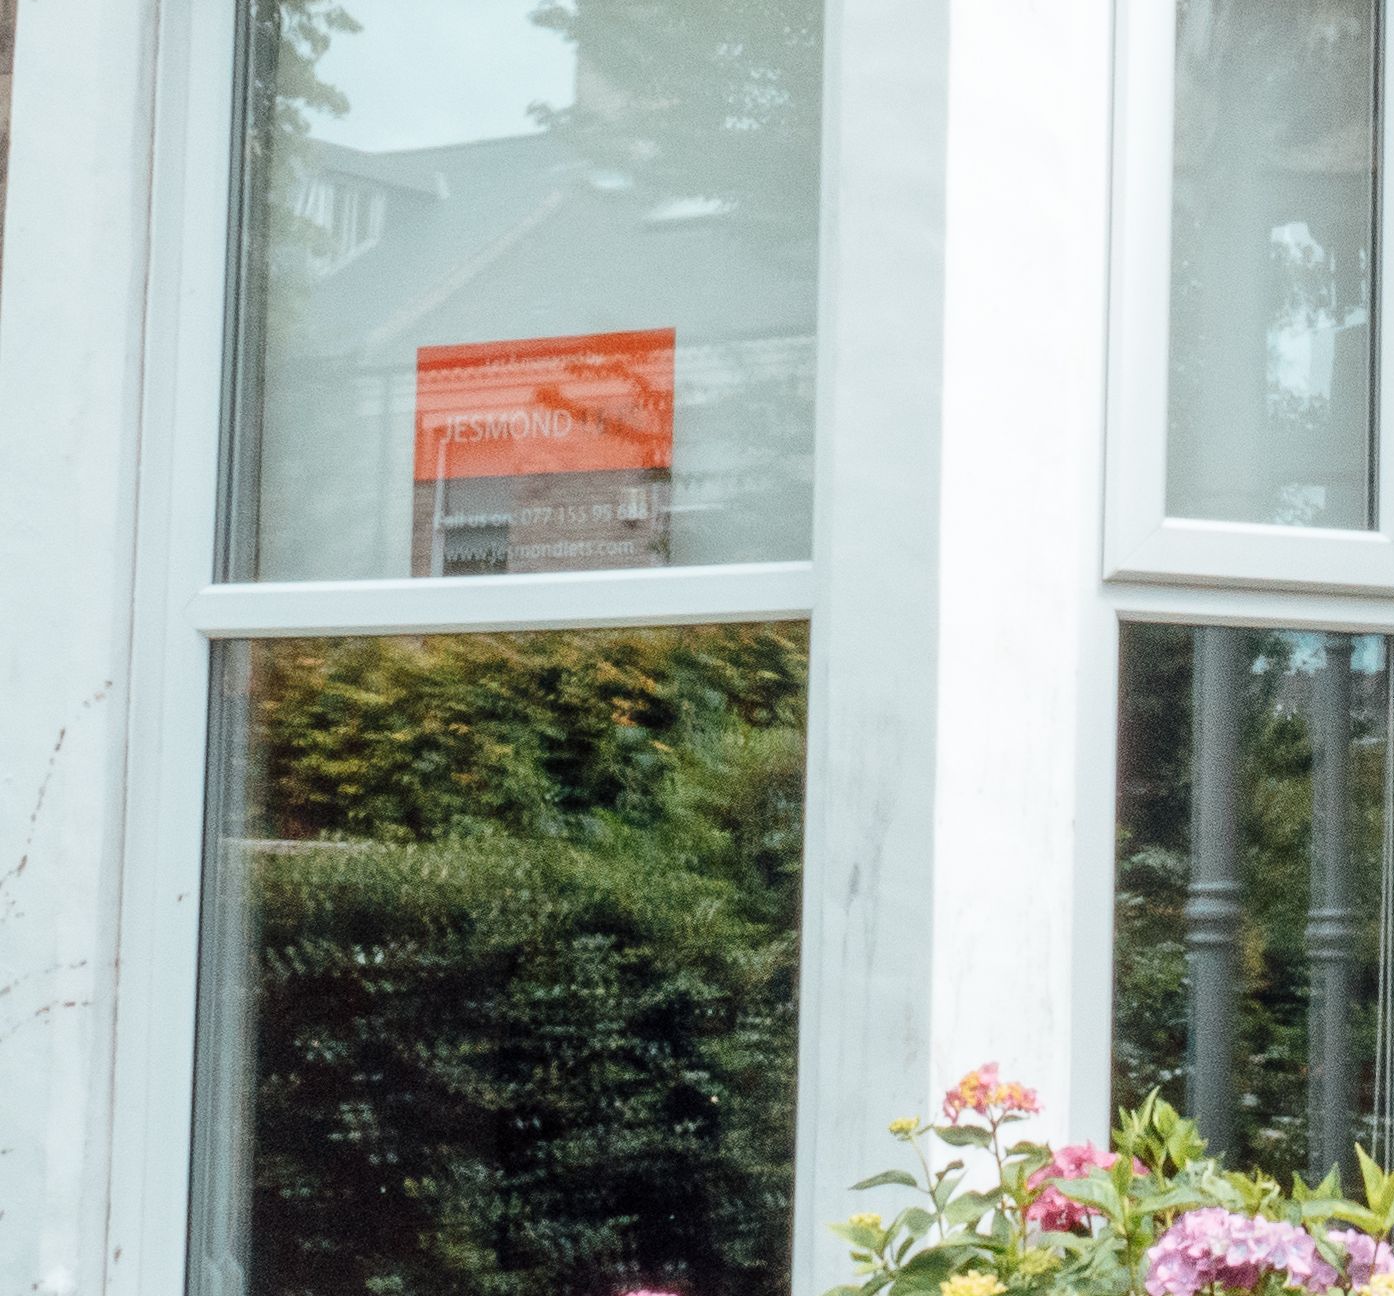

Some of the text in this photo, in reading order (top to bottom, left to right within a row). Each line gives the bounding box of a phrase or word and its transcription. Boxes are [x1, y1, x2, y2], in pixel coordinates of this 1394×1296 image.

[444, 409, 573, 443] JESMOND
[520, 506, 552, 525] 077
[444, 540, 636, 565] www.jesmondlets.com
